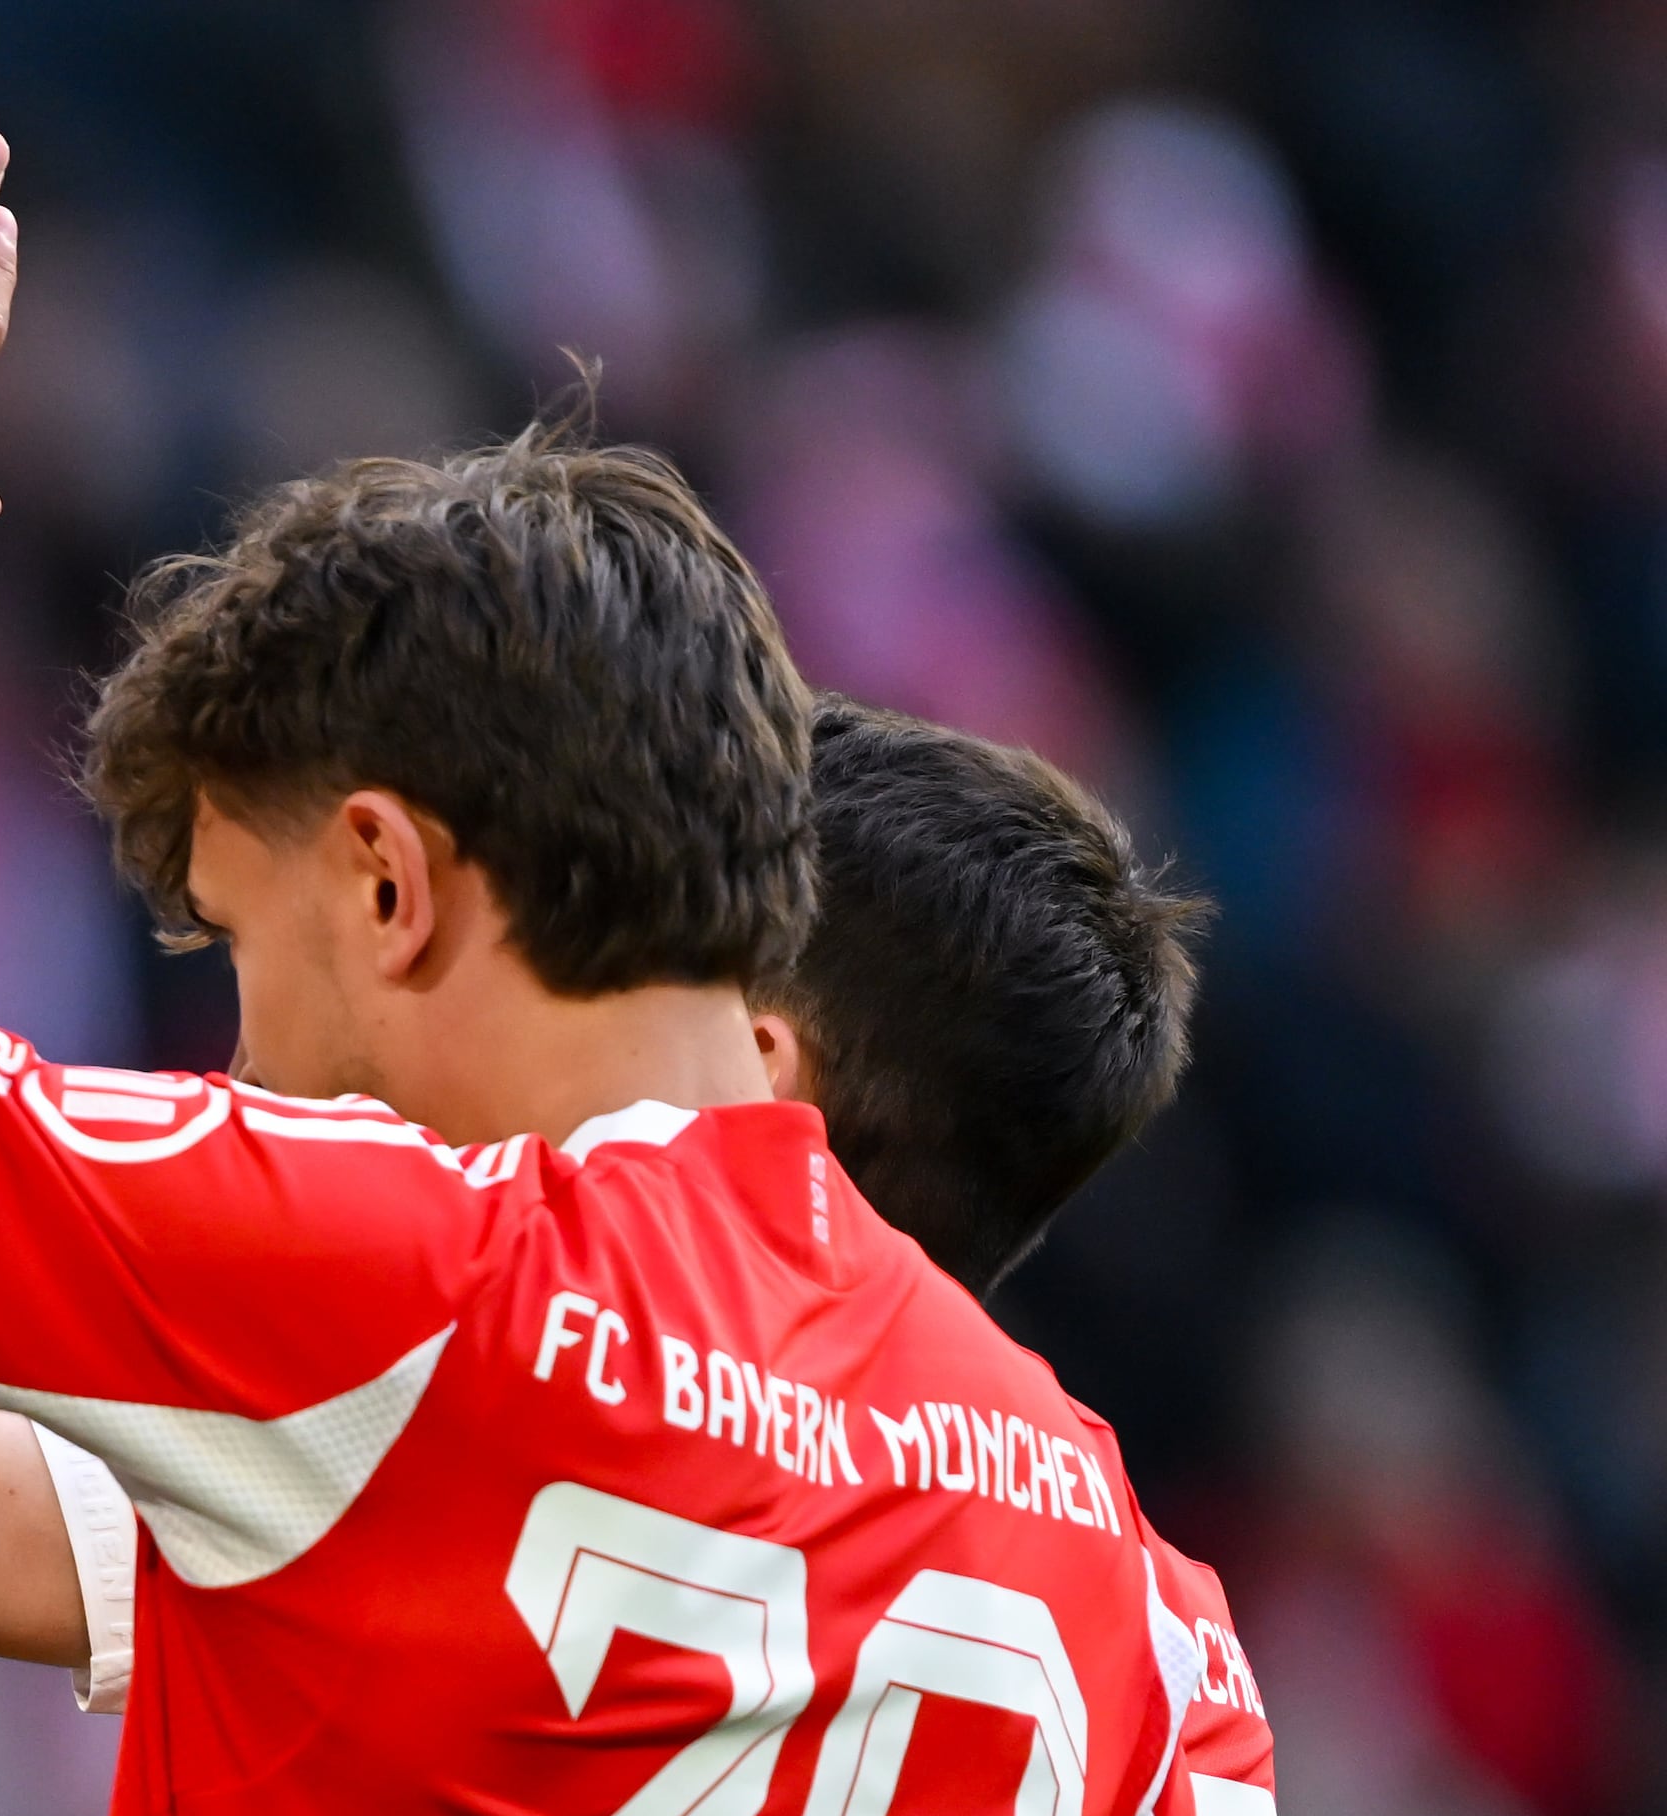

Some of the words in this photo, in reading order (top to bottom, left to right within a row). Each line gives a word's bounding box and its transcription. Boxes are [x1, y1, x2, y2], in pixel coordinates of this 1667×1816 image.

[533, 1290, 630, 1406] FC
[661, 1333, 863, 1487] BAYERN
[868, 1402, 1122, 1537] MÜNCHEN
